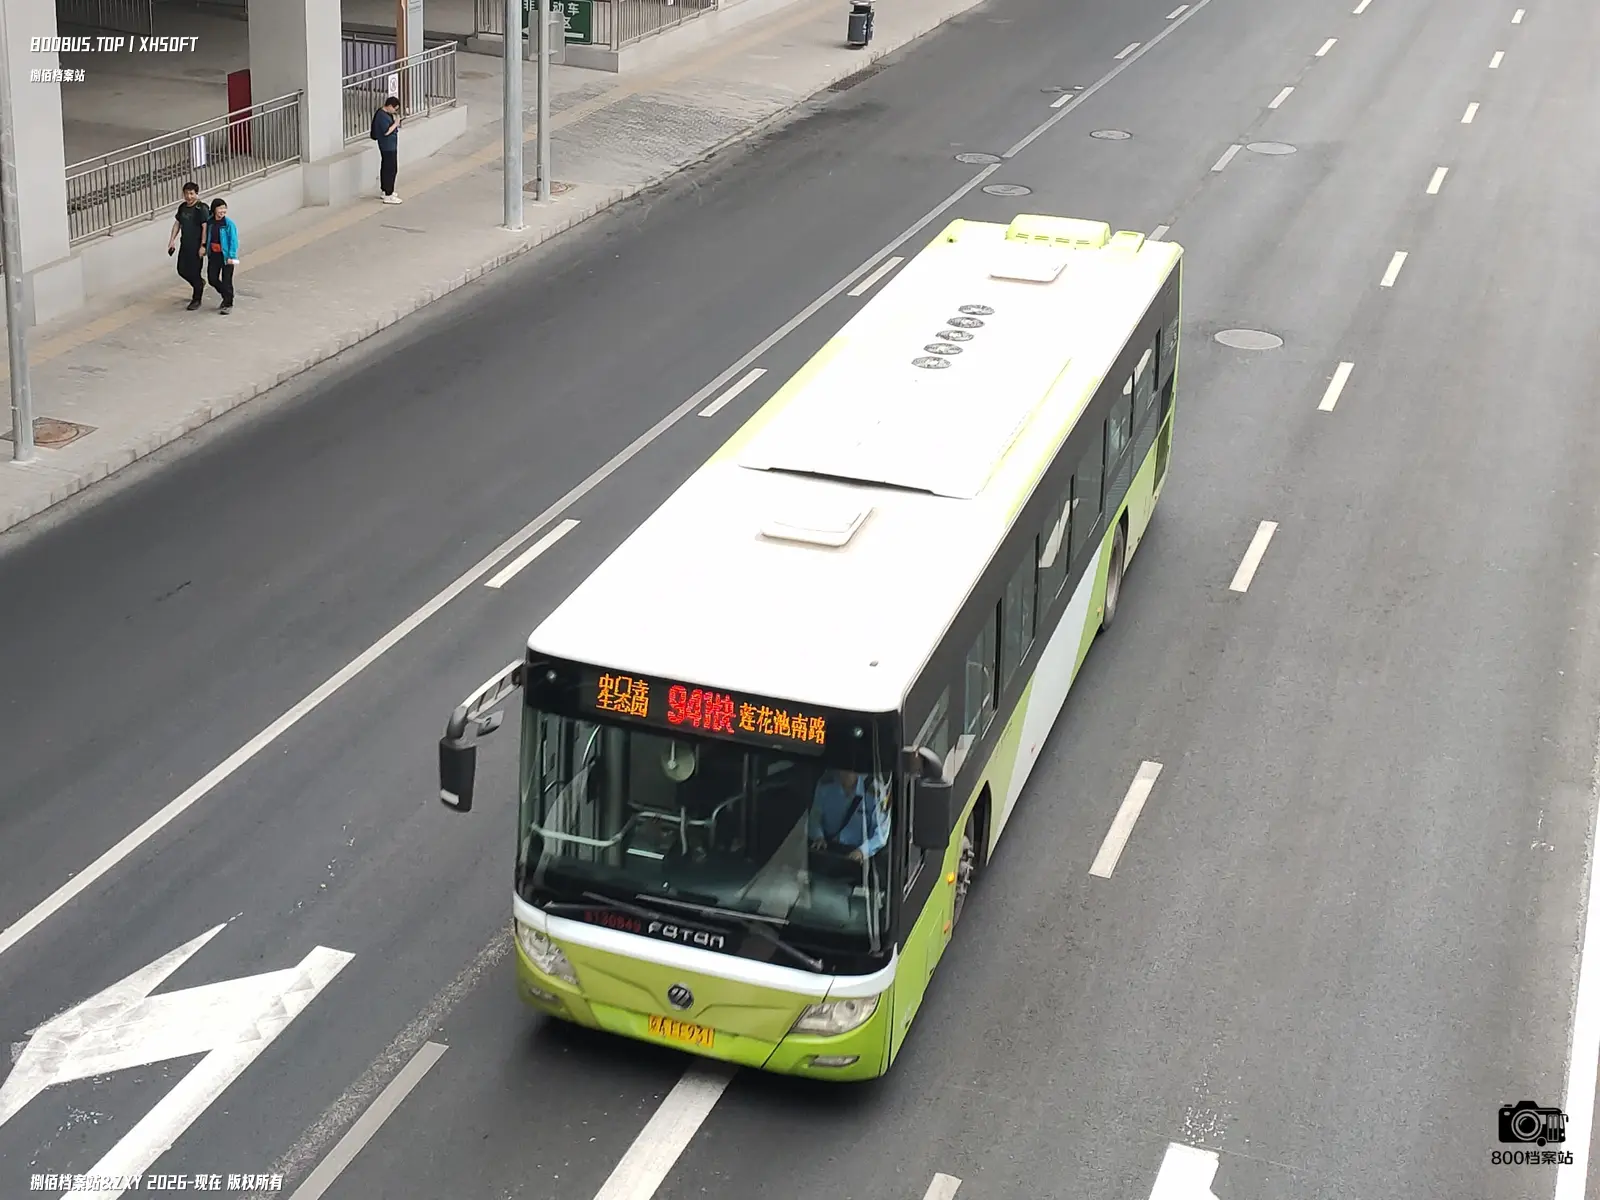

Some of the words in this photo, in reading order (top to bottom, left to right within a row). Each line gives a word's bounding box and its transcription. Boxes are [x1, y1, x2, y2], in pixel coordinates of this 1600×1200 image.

[523, 0, 580, 15] 非动车
[738, 702, 826, 744] 莲花池南路
